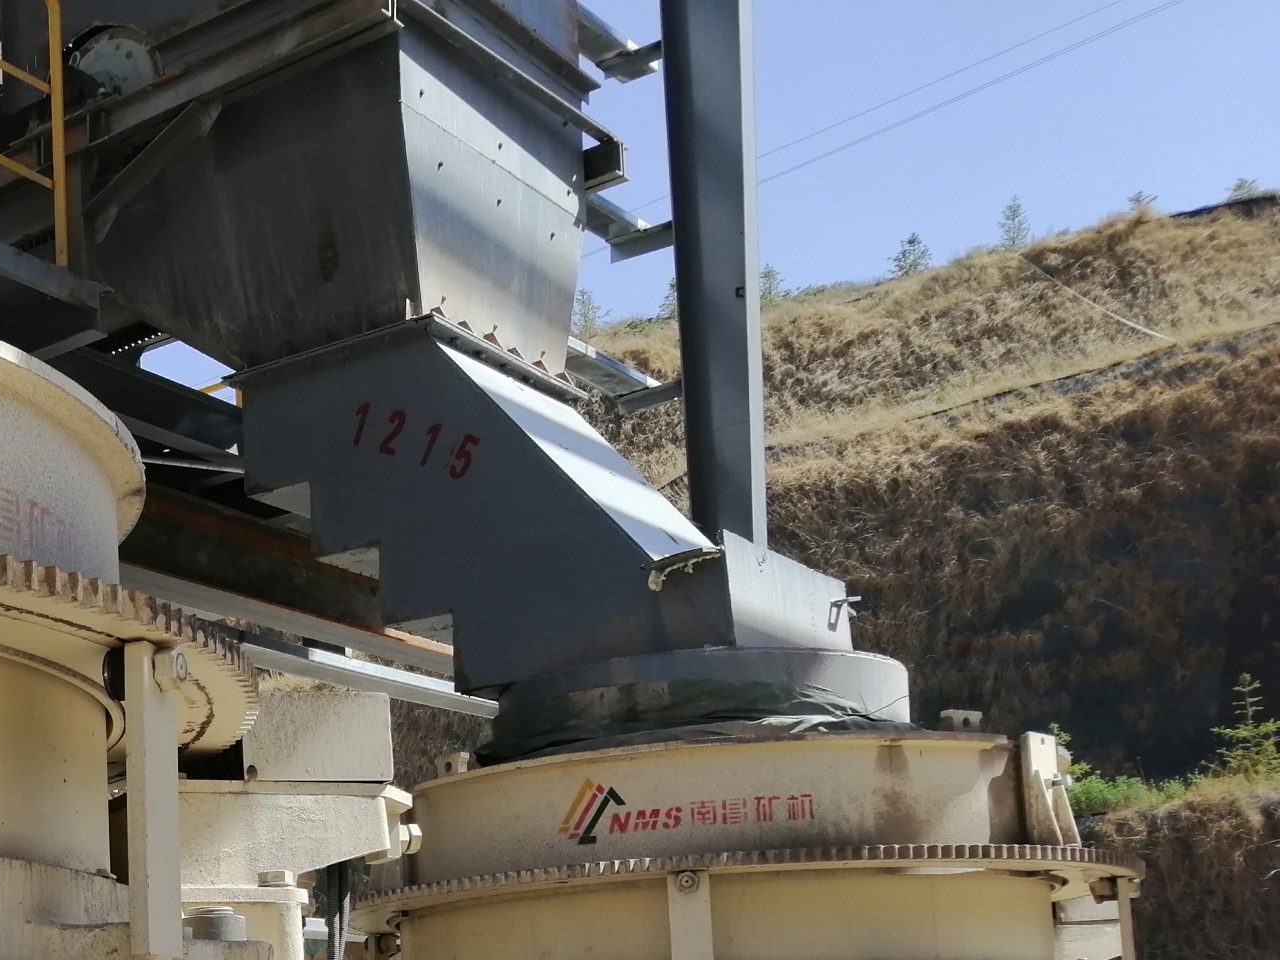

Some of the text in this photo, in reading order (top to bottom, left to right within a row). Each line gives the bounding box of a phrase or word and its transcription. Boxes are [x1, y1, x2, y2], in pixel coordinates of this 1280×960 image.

[353, 402, 480, 480] 1215
[608, 793, 815, 835] NMS 南昌矿机
